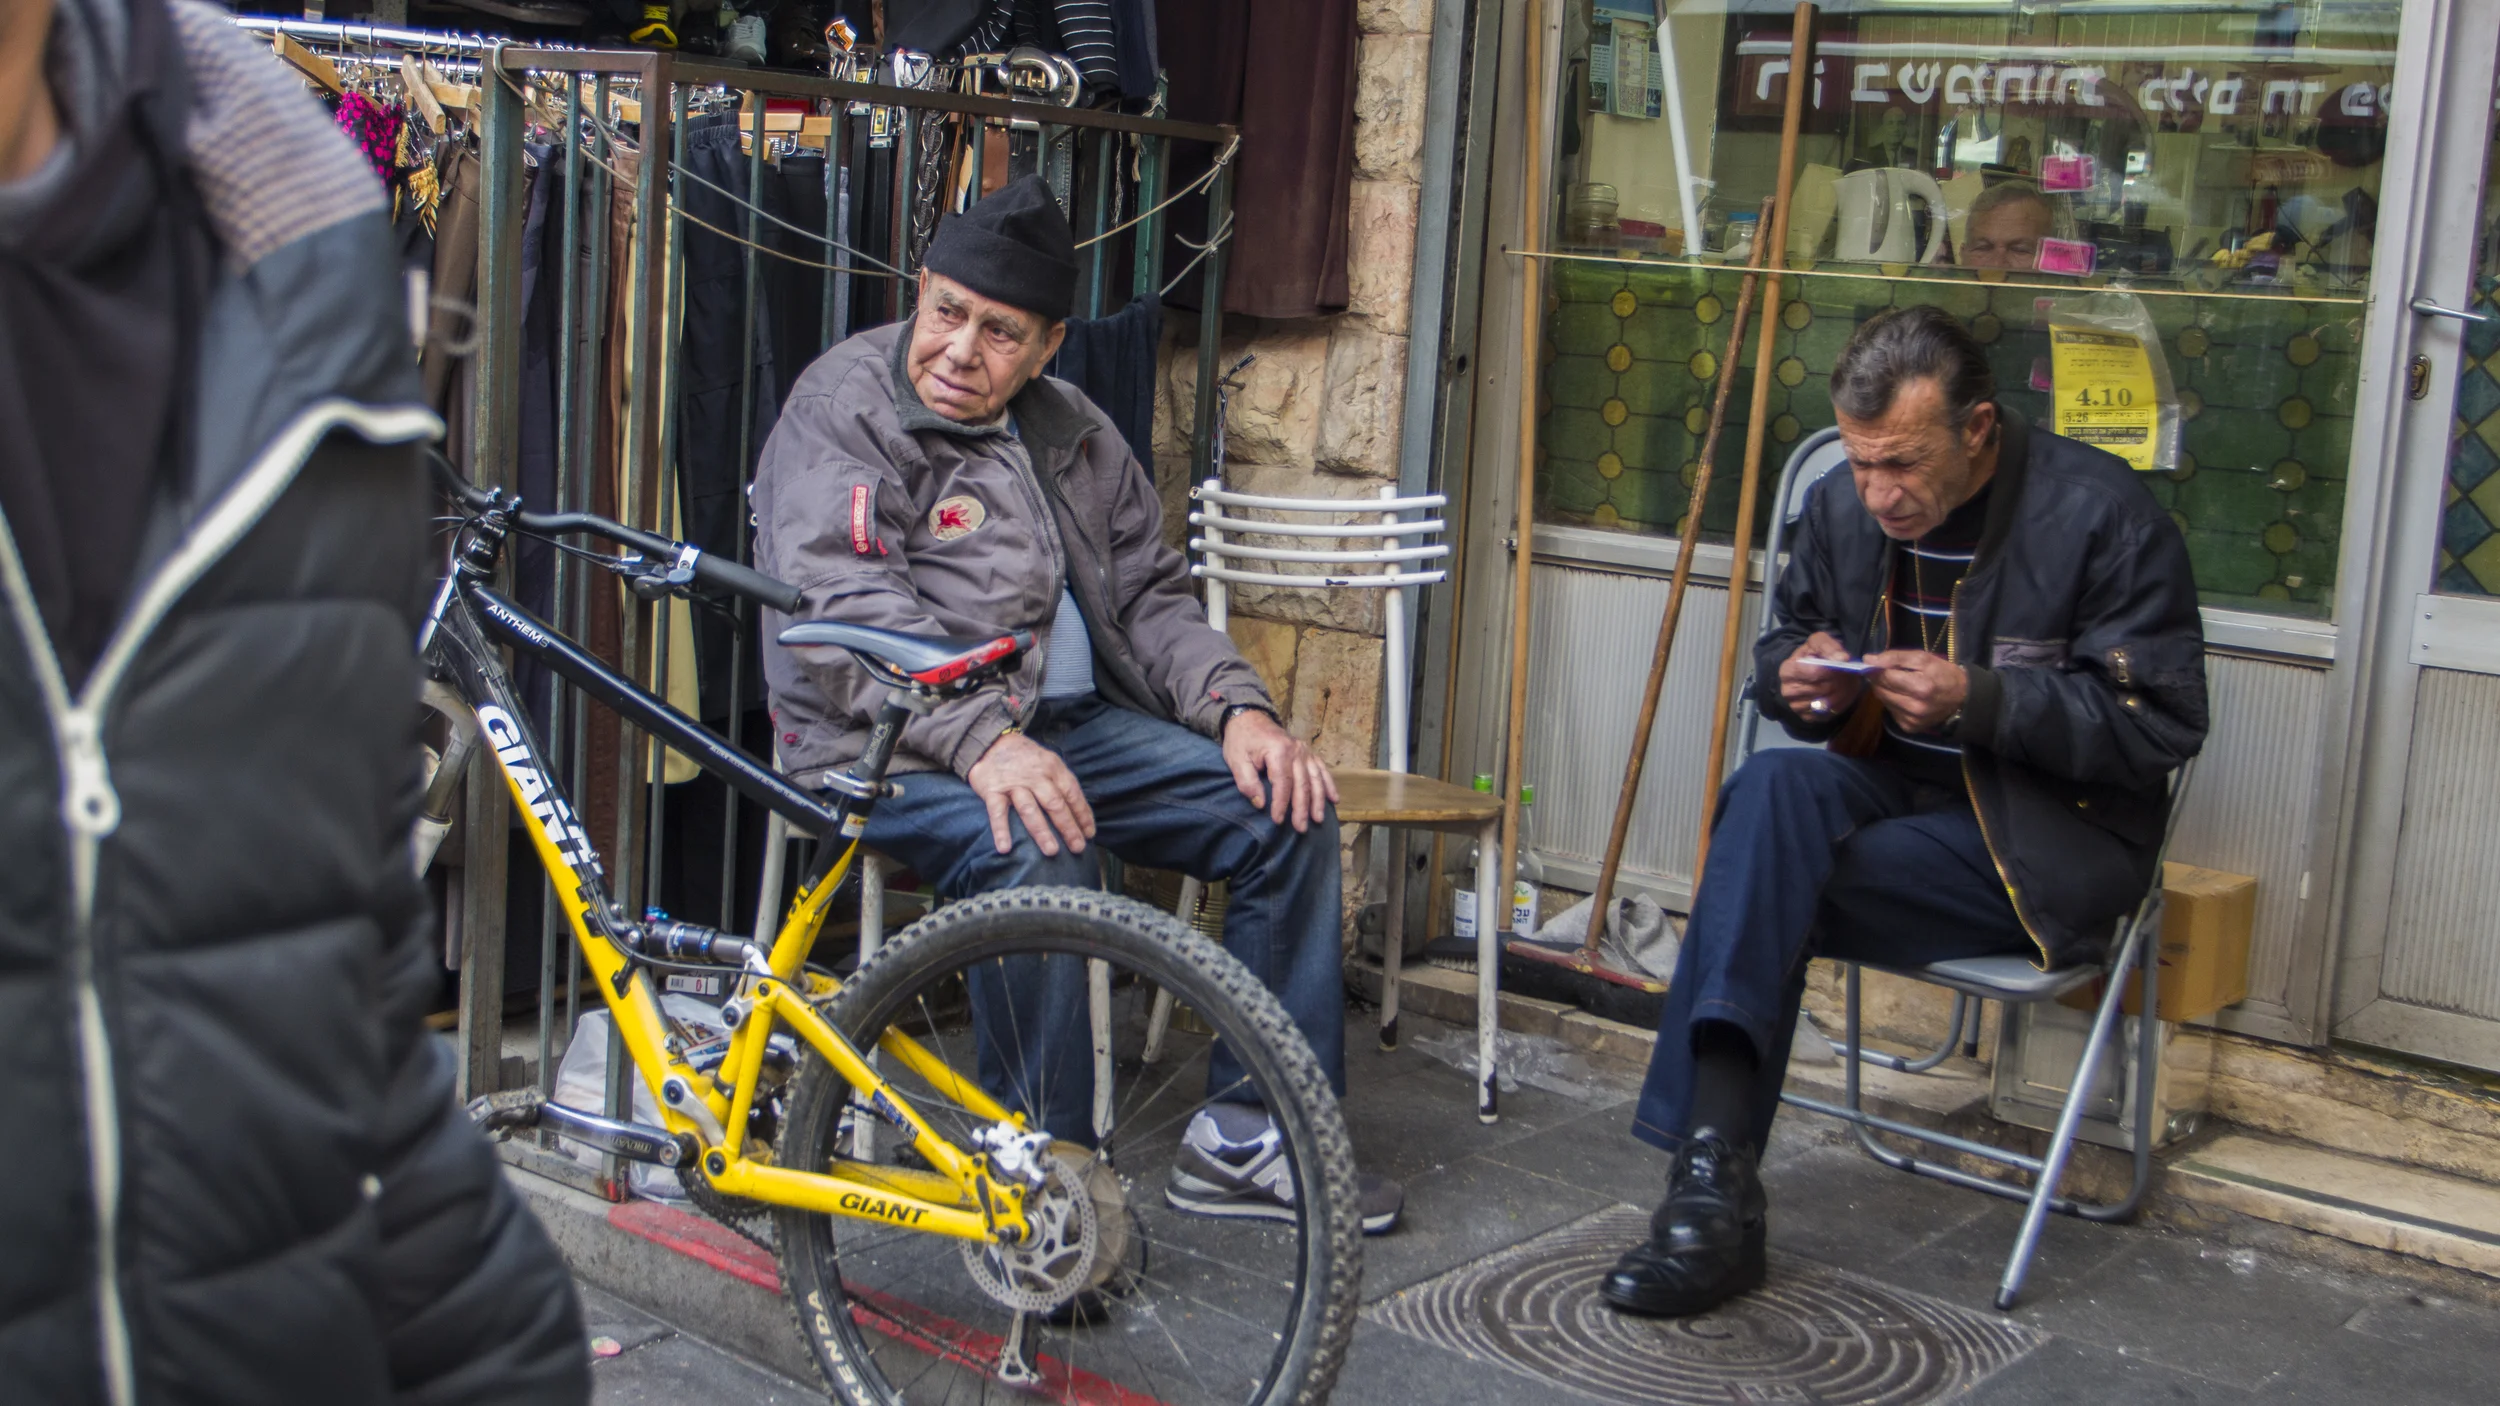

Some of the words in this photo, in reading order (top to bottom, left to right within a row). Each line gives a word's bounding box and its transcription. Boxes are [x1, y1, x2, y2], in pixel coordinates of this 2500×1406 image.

[2075, 387, 2132, 407] 4.10
[2065, 411, 2089, 423] 5.26
[855, 488, 865, 522] COOPER
[855, 523, 864, 540] LEE
[478, 705, 604, 875] GIANT
[839, 1192, 930, 1225] GIANT
[807, 1289, 872, 1406] KENDA
